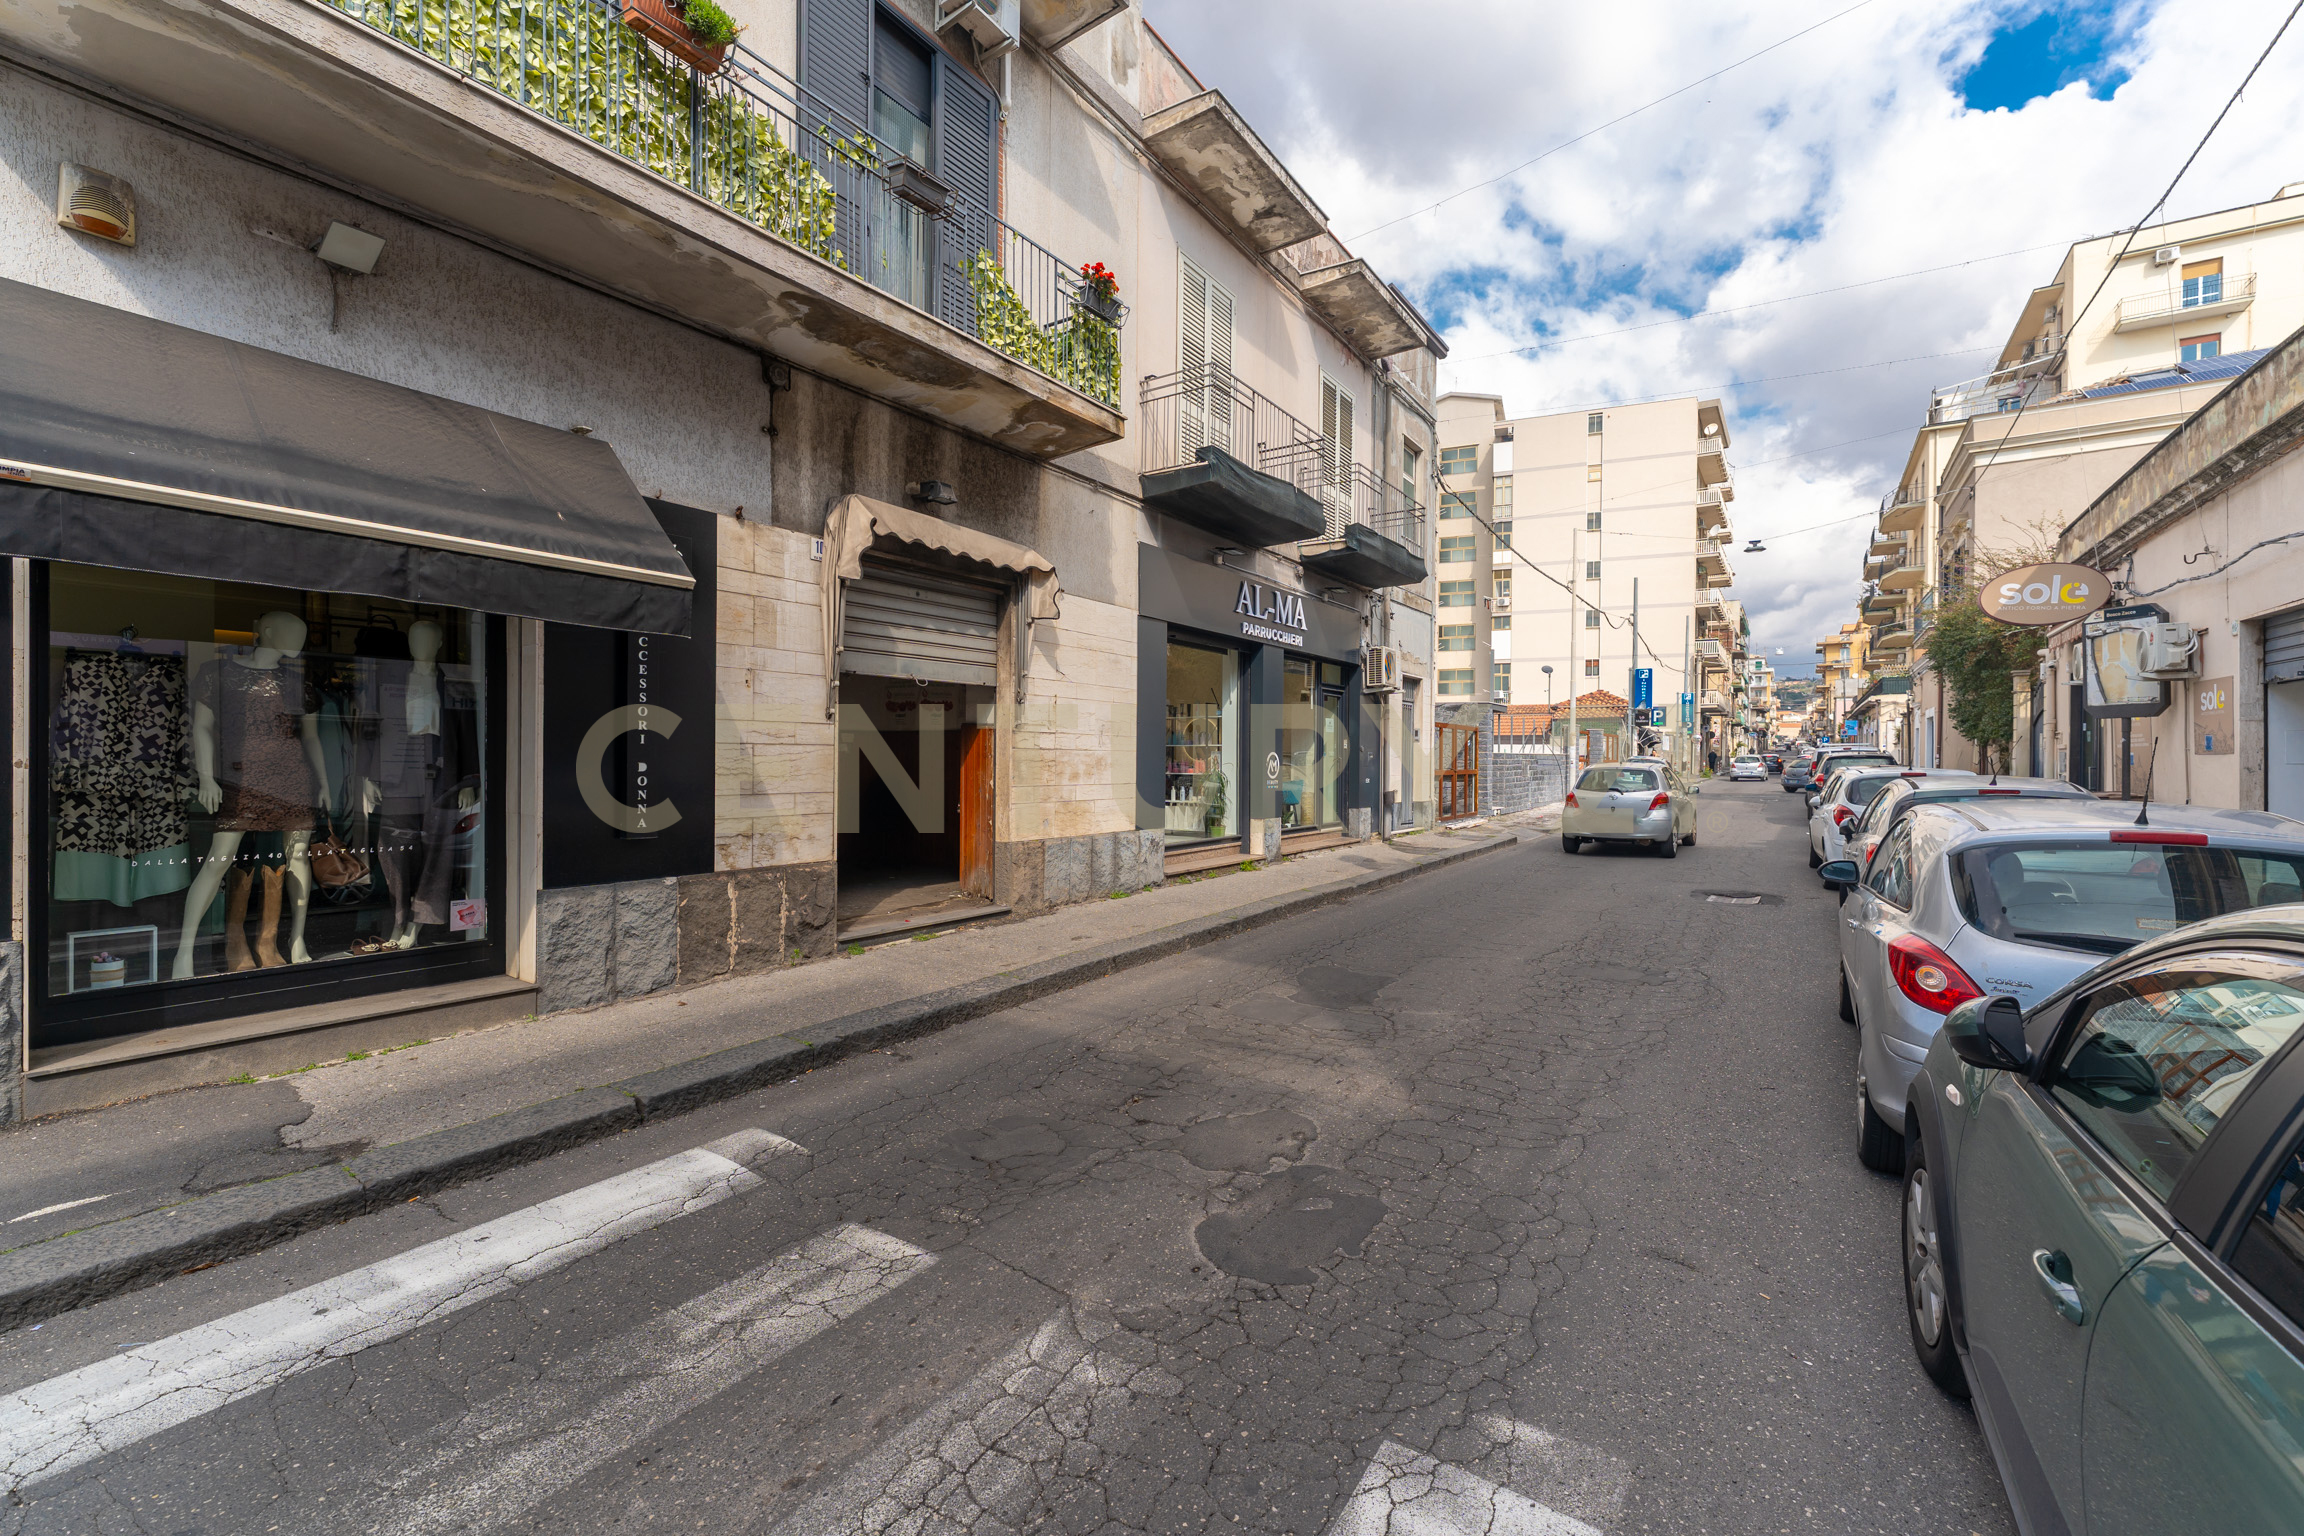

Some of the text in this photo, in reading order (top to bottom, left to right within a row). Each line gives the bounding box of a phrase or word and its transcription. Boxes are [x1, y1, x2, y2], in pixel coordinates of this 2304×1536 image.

[1235, 580, 1308, 631] AL-MA
[1241, 621, 1303, 647] PARRUCCHIERI
[1653, 710, 1664, 722] P
[637, 636, 649, 829] CCESSORI DONNA
[131, 857, 188, 867] DALLA
[197, 853, 260, 863] TAGLIA
[298, 849, 333, 857] ALLA
[340, 846, 393, 854] TAGLIA
[1985, 977, 2034, 990] CORSA
